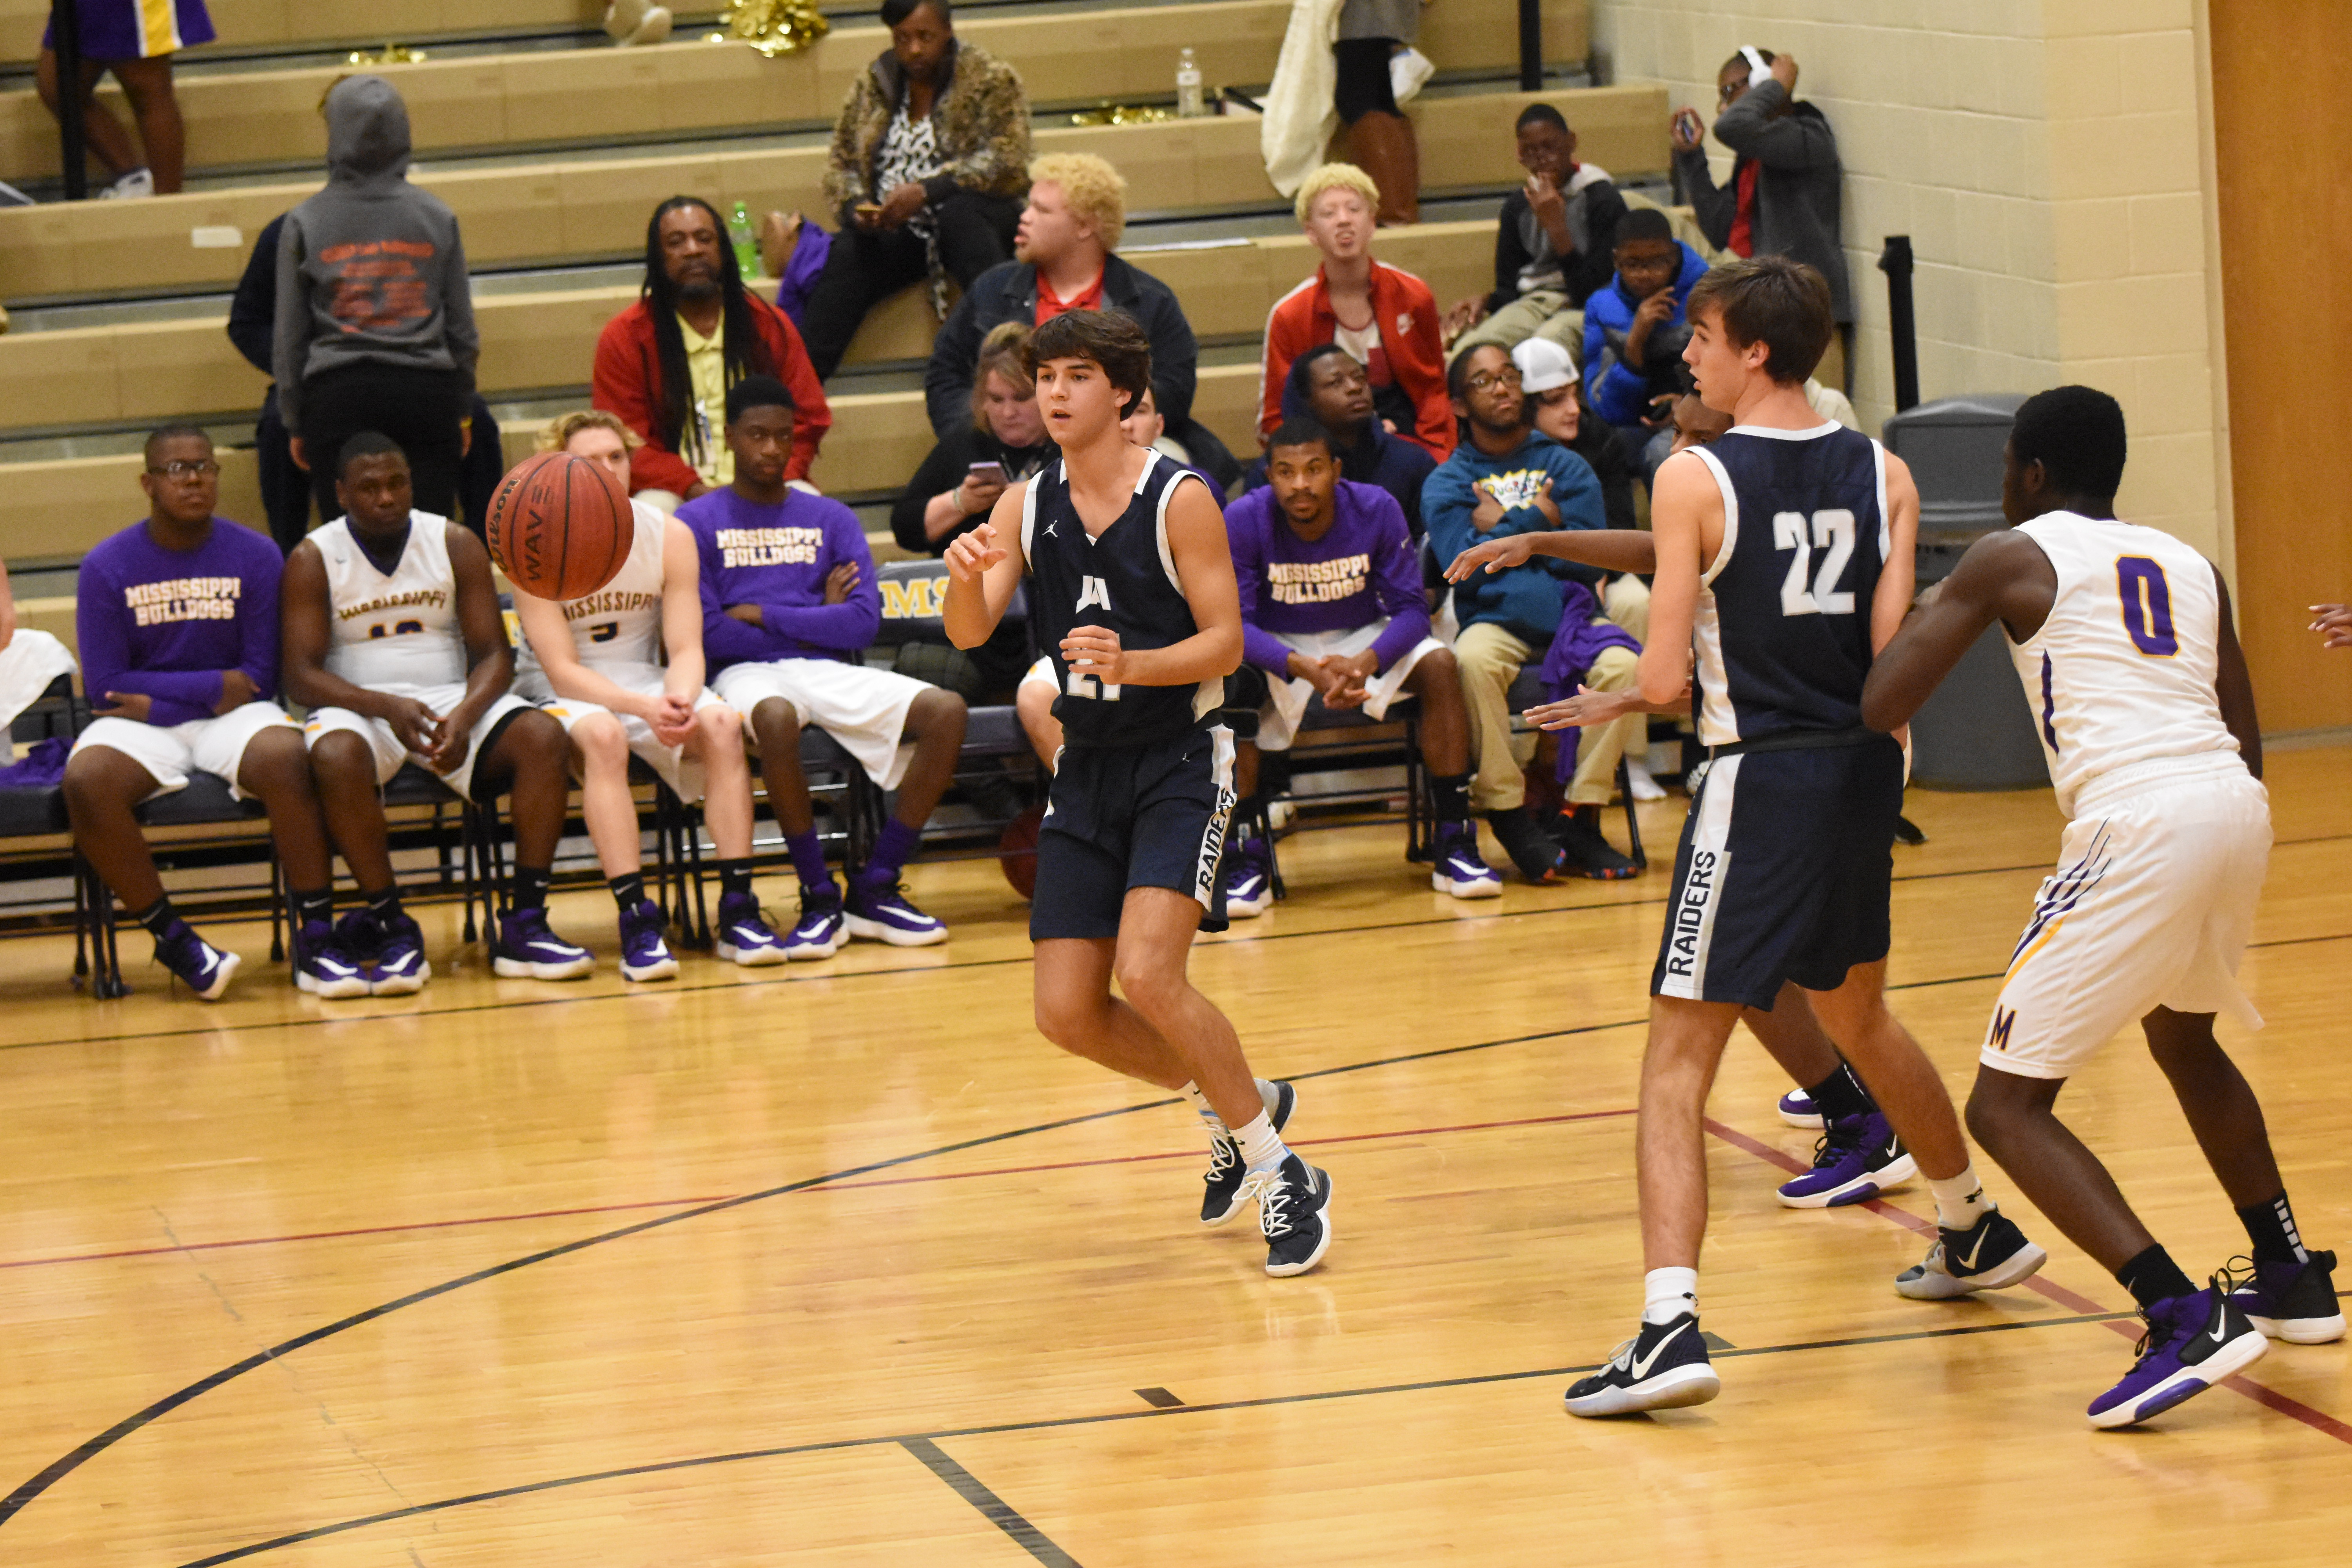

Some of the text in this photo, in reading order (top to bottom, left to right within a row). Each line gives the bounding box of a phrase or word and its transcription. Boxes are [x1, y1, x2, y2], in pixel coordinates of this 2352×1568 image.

[715, 526, 823, 549] MISSISSIPPI
[723, 543, 817, 568] BULLDOGS
[1267, 553, 1370, 584] MISSISSIPPI
[1772, 509, 1856, 617] 22
[124, 577, 241, 608] MISSISSIPPI
[1271, 575, 1366, 604] BULLDOGS
[134, 598, 235, 627] BULLDOGS
[2113, 553, 2182, 659] 0
[1668, 851, 1717, 977] RAIDERS
[1989, 1003, 2018, 1053] M
